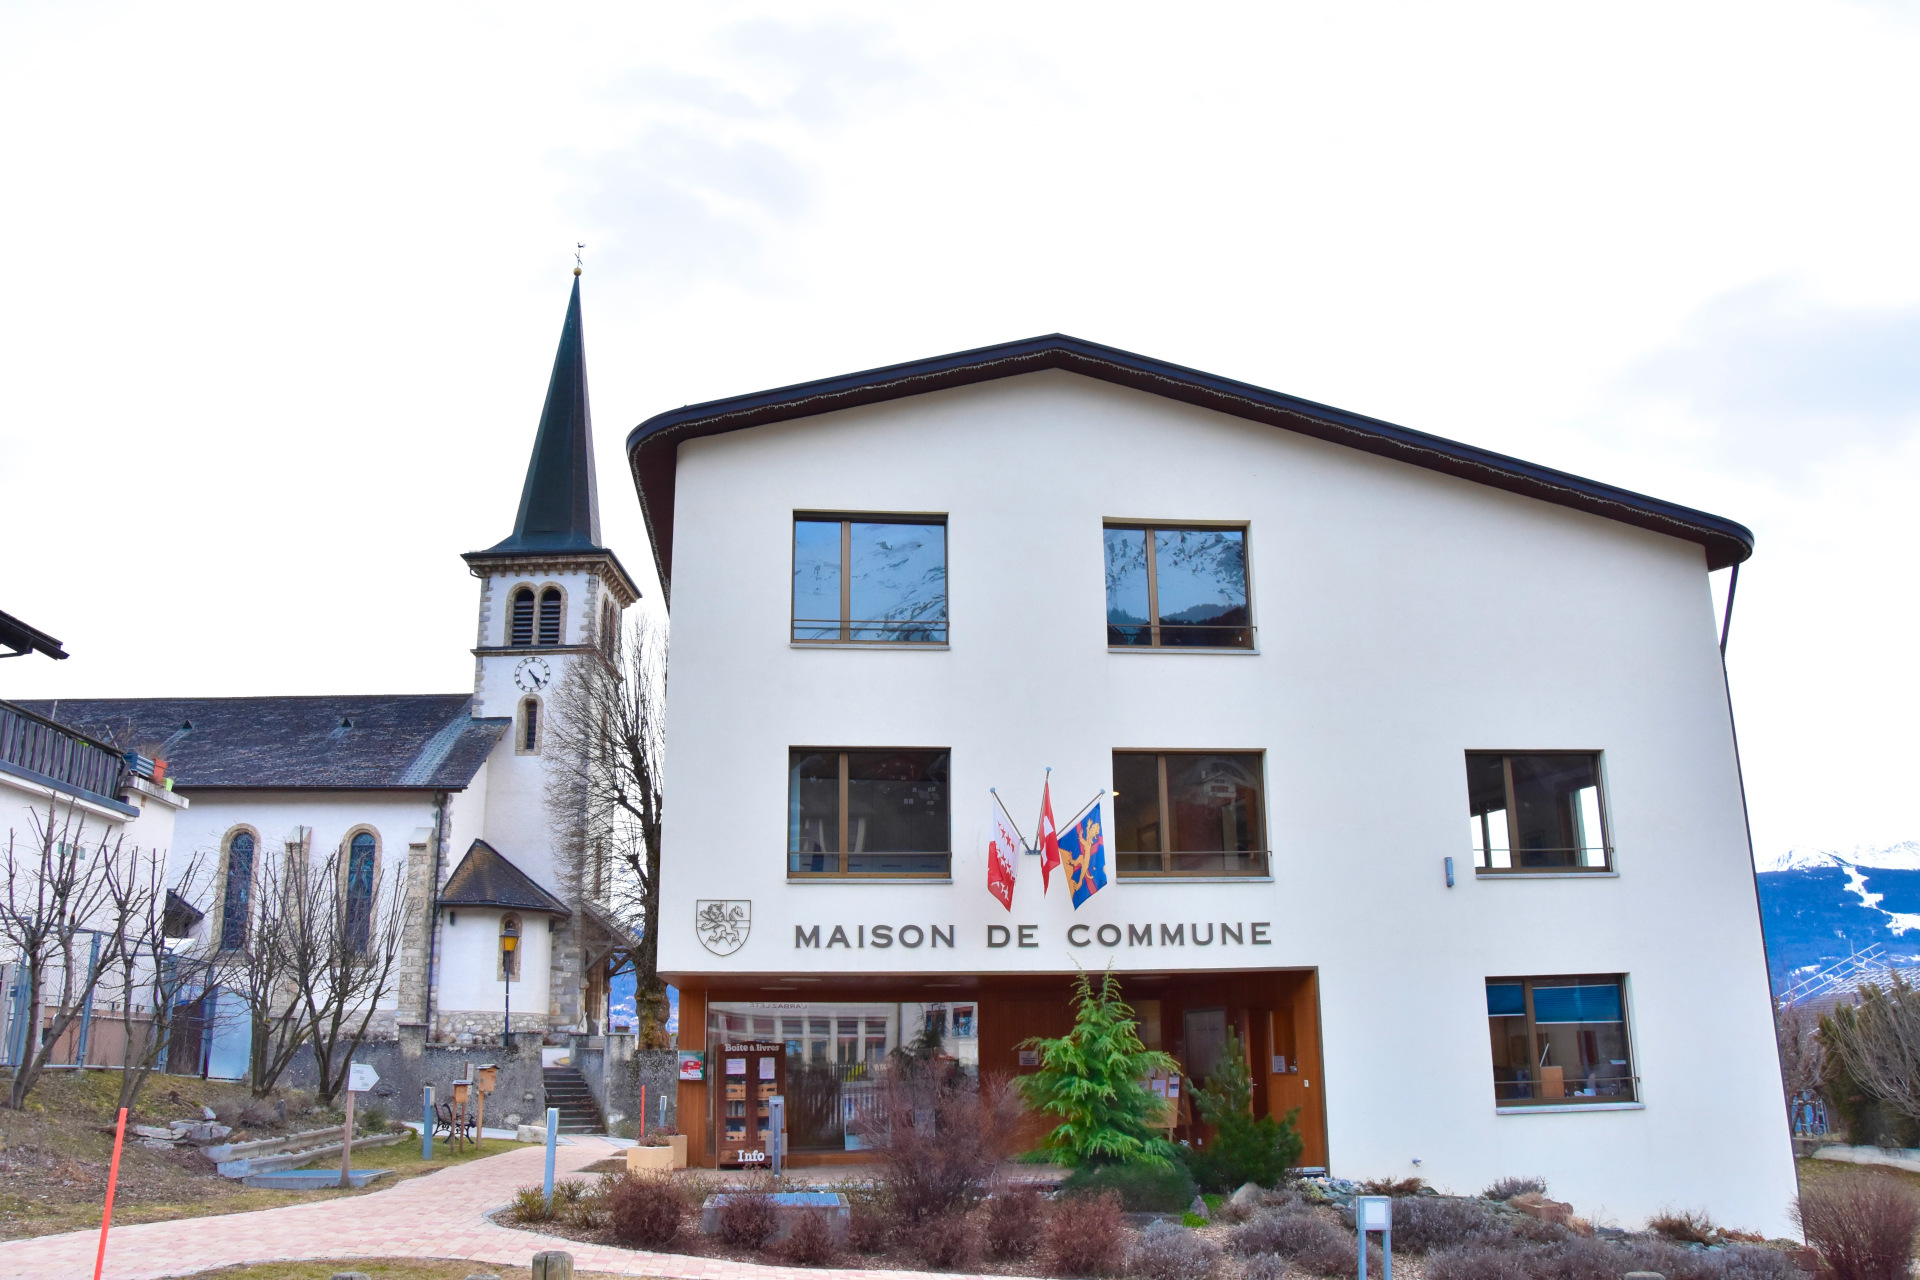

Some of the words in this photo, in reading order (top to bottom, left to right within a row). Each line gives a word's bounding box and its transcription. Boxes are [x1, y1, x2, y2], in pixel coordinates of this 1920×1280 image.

[794, 924, 955, 949] MAISON
[986, 924, 1039, 949] DE
[1067, 921, 1272, 948] COMMUNE
[756, 1043, 780, 1052] livres
[737, 1149, 765, 1162] Info
